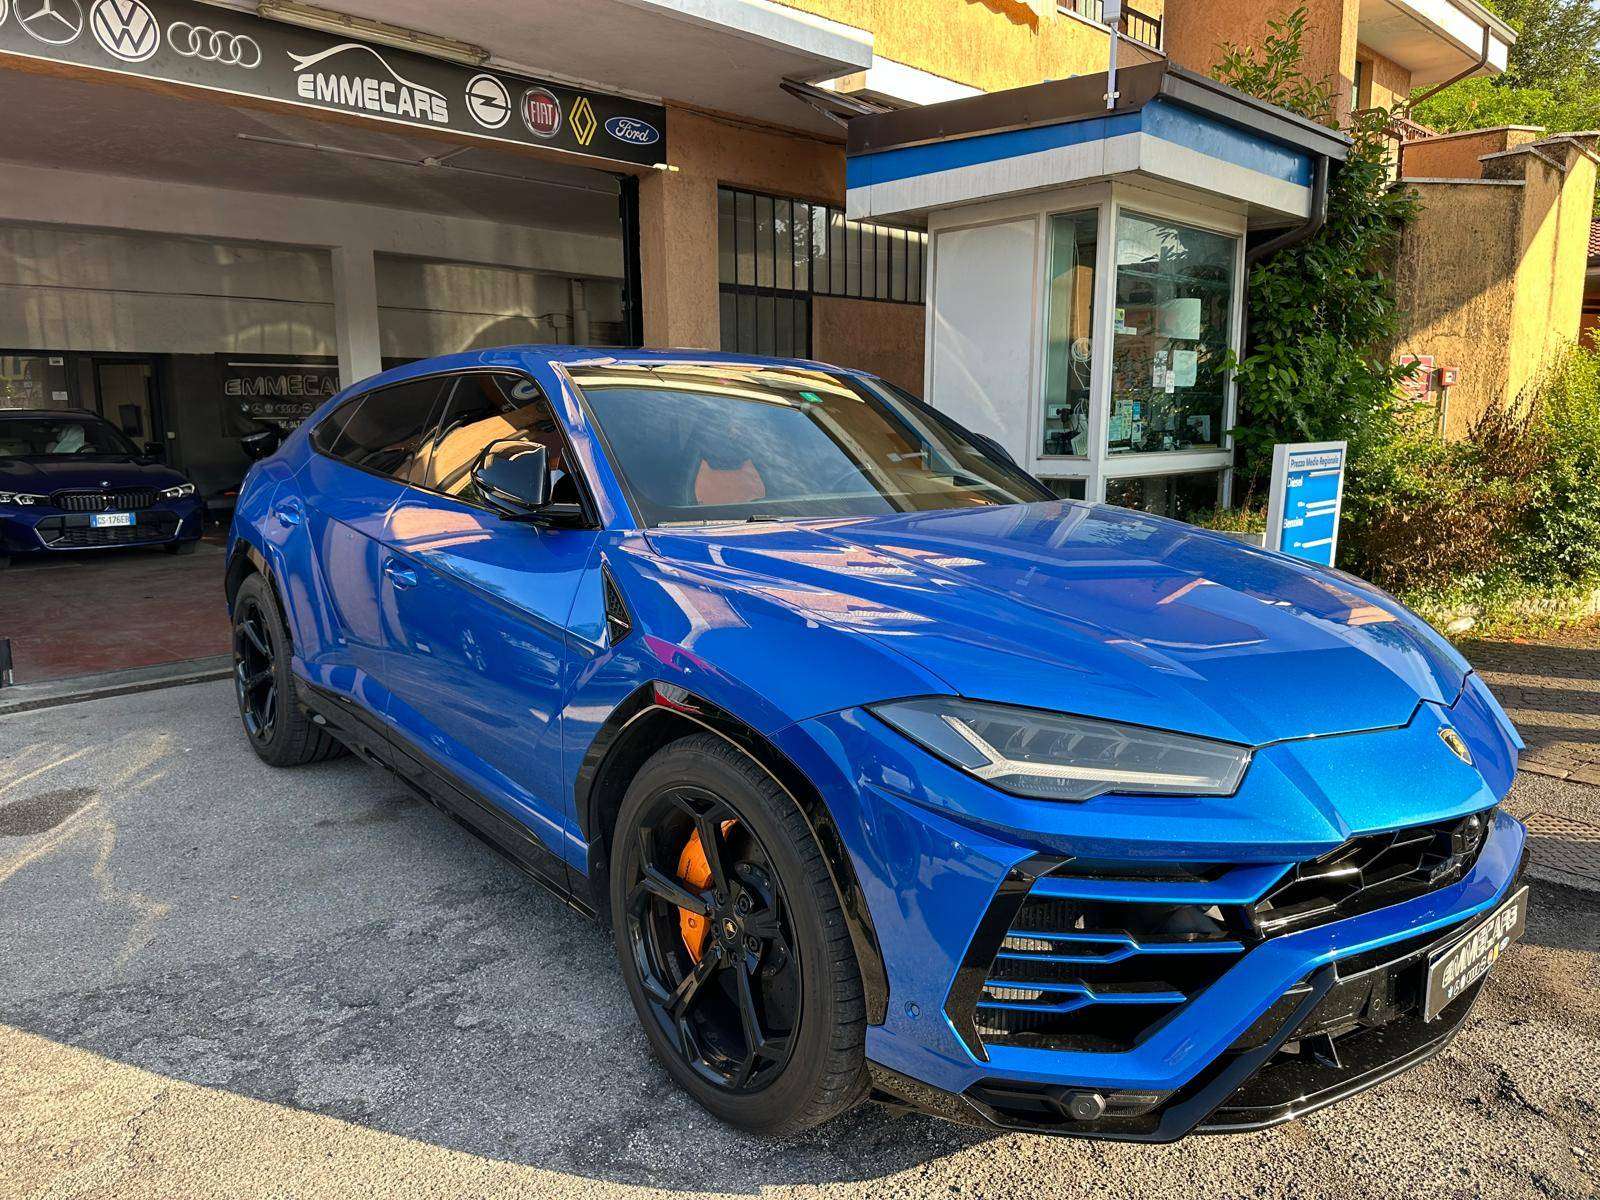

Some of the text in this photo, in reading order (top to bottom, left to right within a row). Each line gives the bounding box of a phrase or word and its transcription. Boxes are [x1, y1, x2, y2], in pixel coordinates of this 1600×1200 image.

[297, 72, 449, 123] EMMECARS
[530, 100, 555, 126] FIAT
[614, 119, 651, 142] Ford
[225, 375, 340, 396] EMMECA
